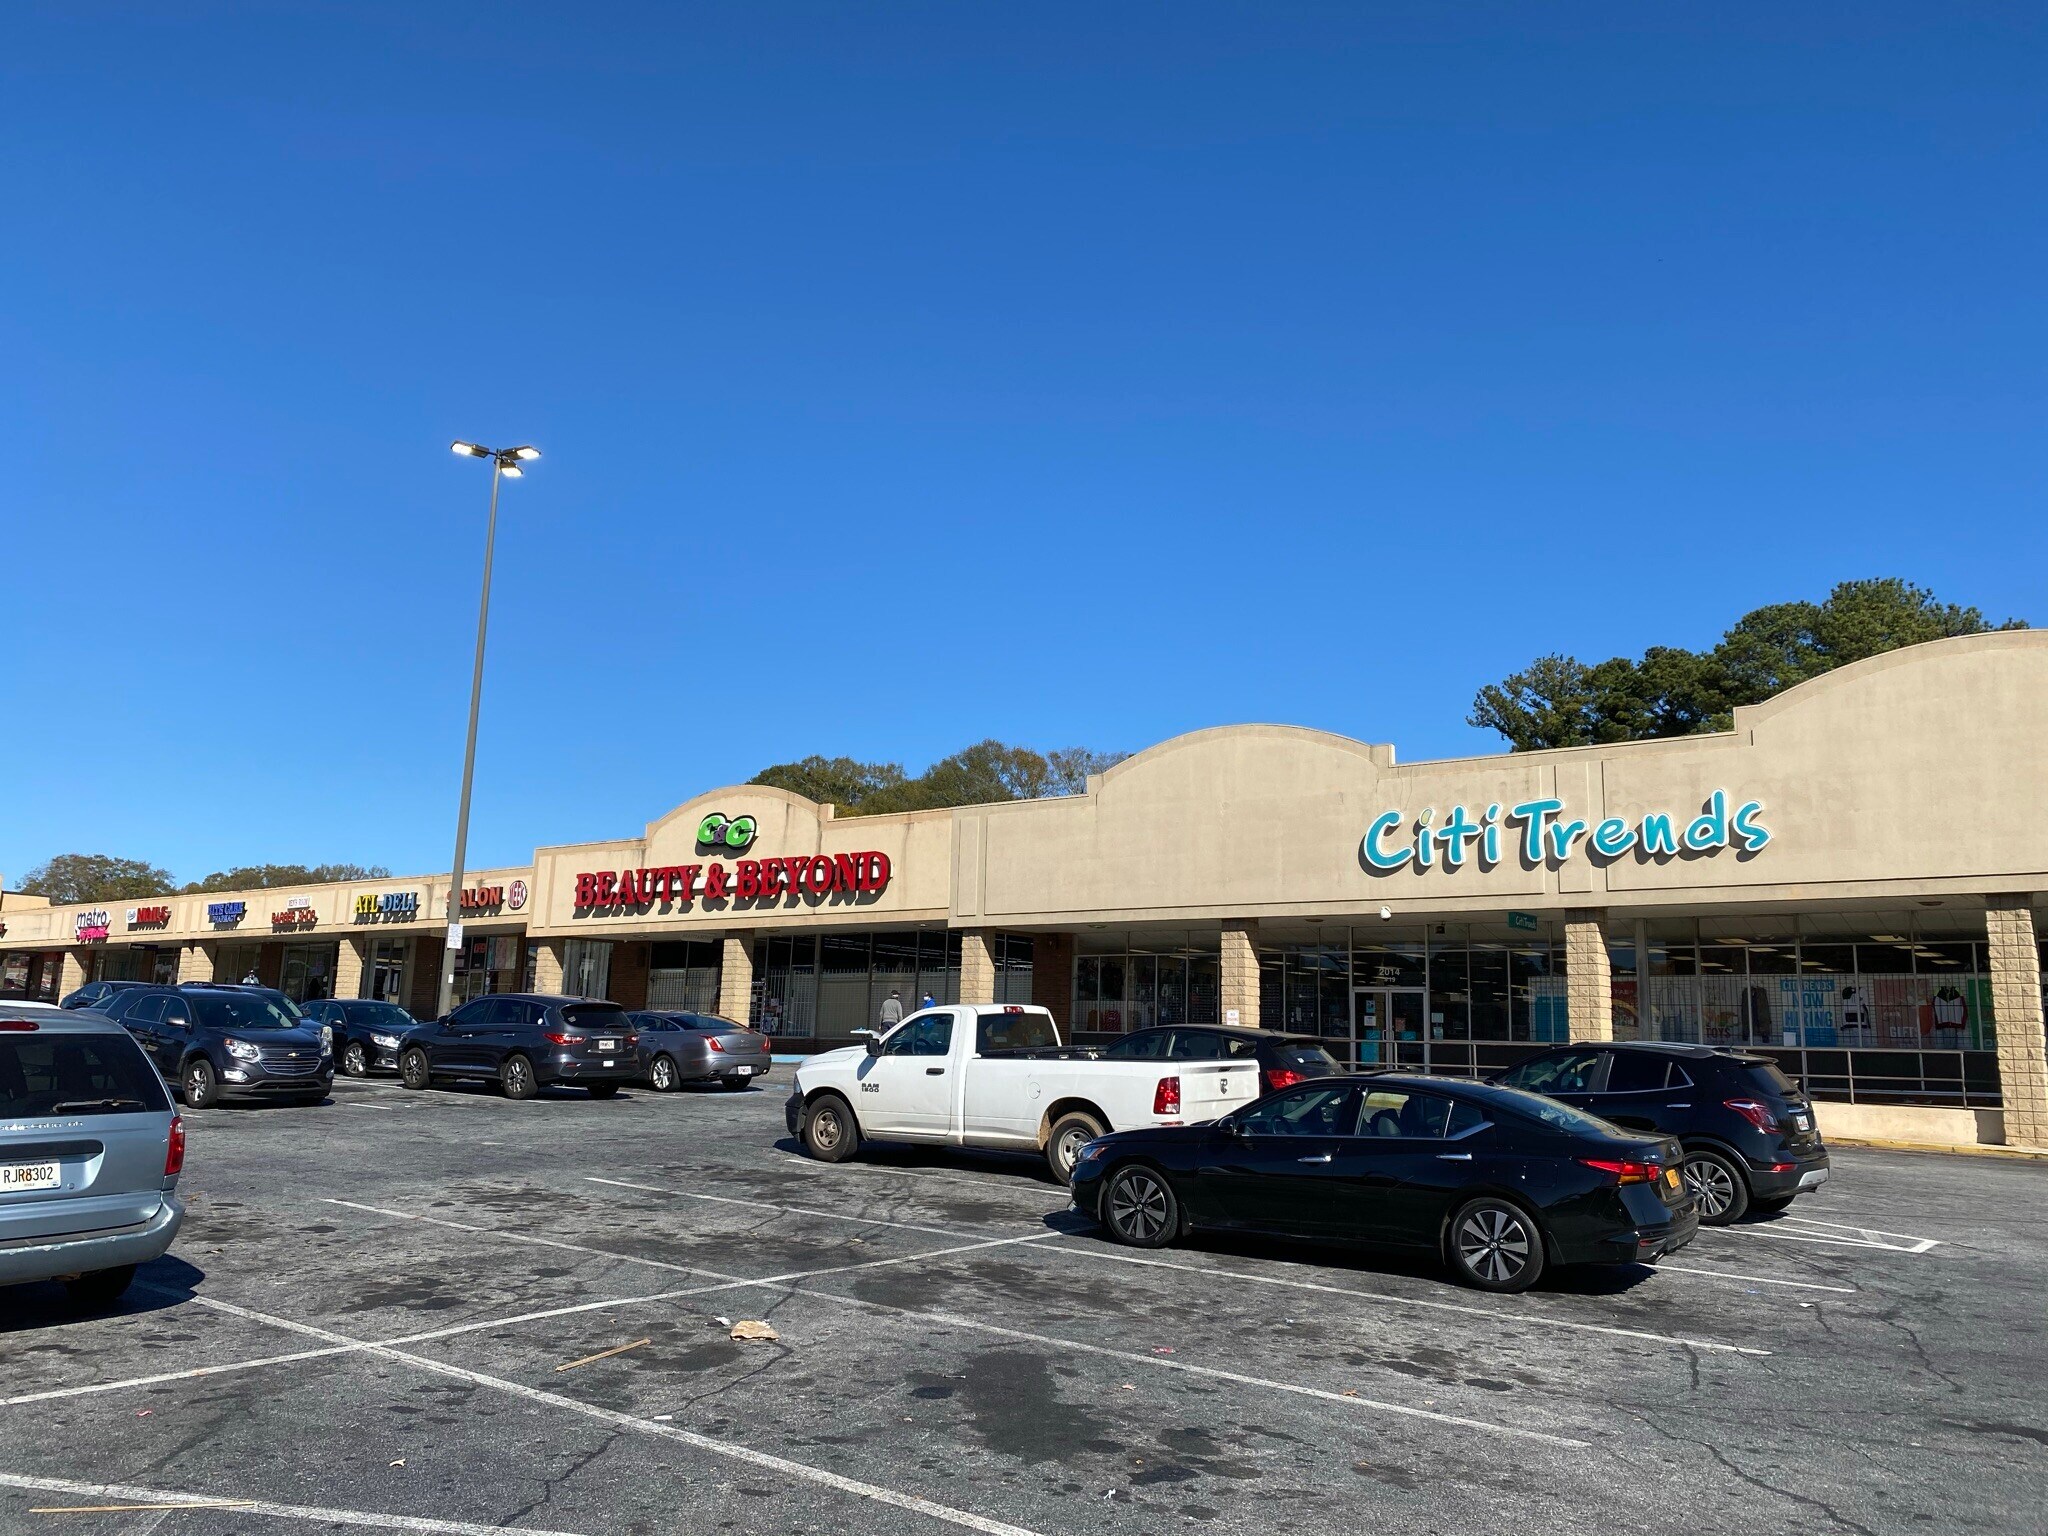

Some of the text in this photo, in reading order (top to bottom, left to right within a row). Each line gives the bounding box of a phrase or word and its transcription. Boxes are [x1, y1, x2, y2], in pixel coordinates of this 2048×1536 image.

[697, 813, 757, 850] C&C
[573, 865, 702, 907] BEAUTY
[736, 851, 891, 897] BEYOND
[353, 892, 418, 914] ATL DELI
[77, 909, 107, 926] metro
[137, 906, 168, 922] NAILS
[271, 909, 316, 923] BARBER SHOP
[1378, 968, 1401, 976] 2014
[1792, 992, 1824, 1008] NOW
[1784, 1011, 1833, 1027] HIRING
[1706, 1027, 1731, 1038] TOYS
[3, 1166, 53, 1184] RJR8302
